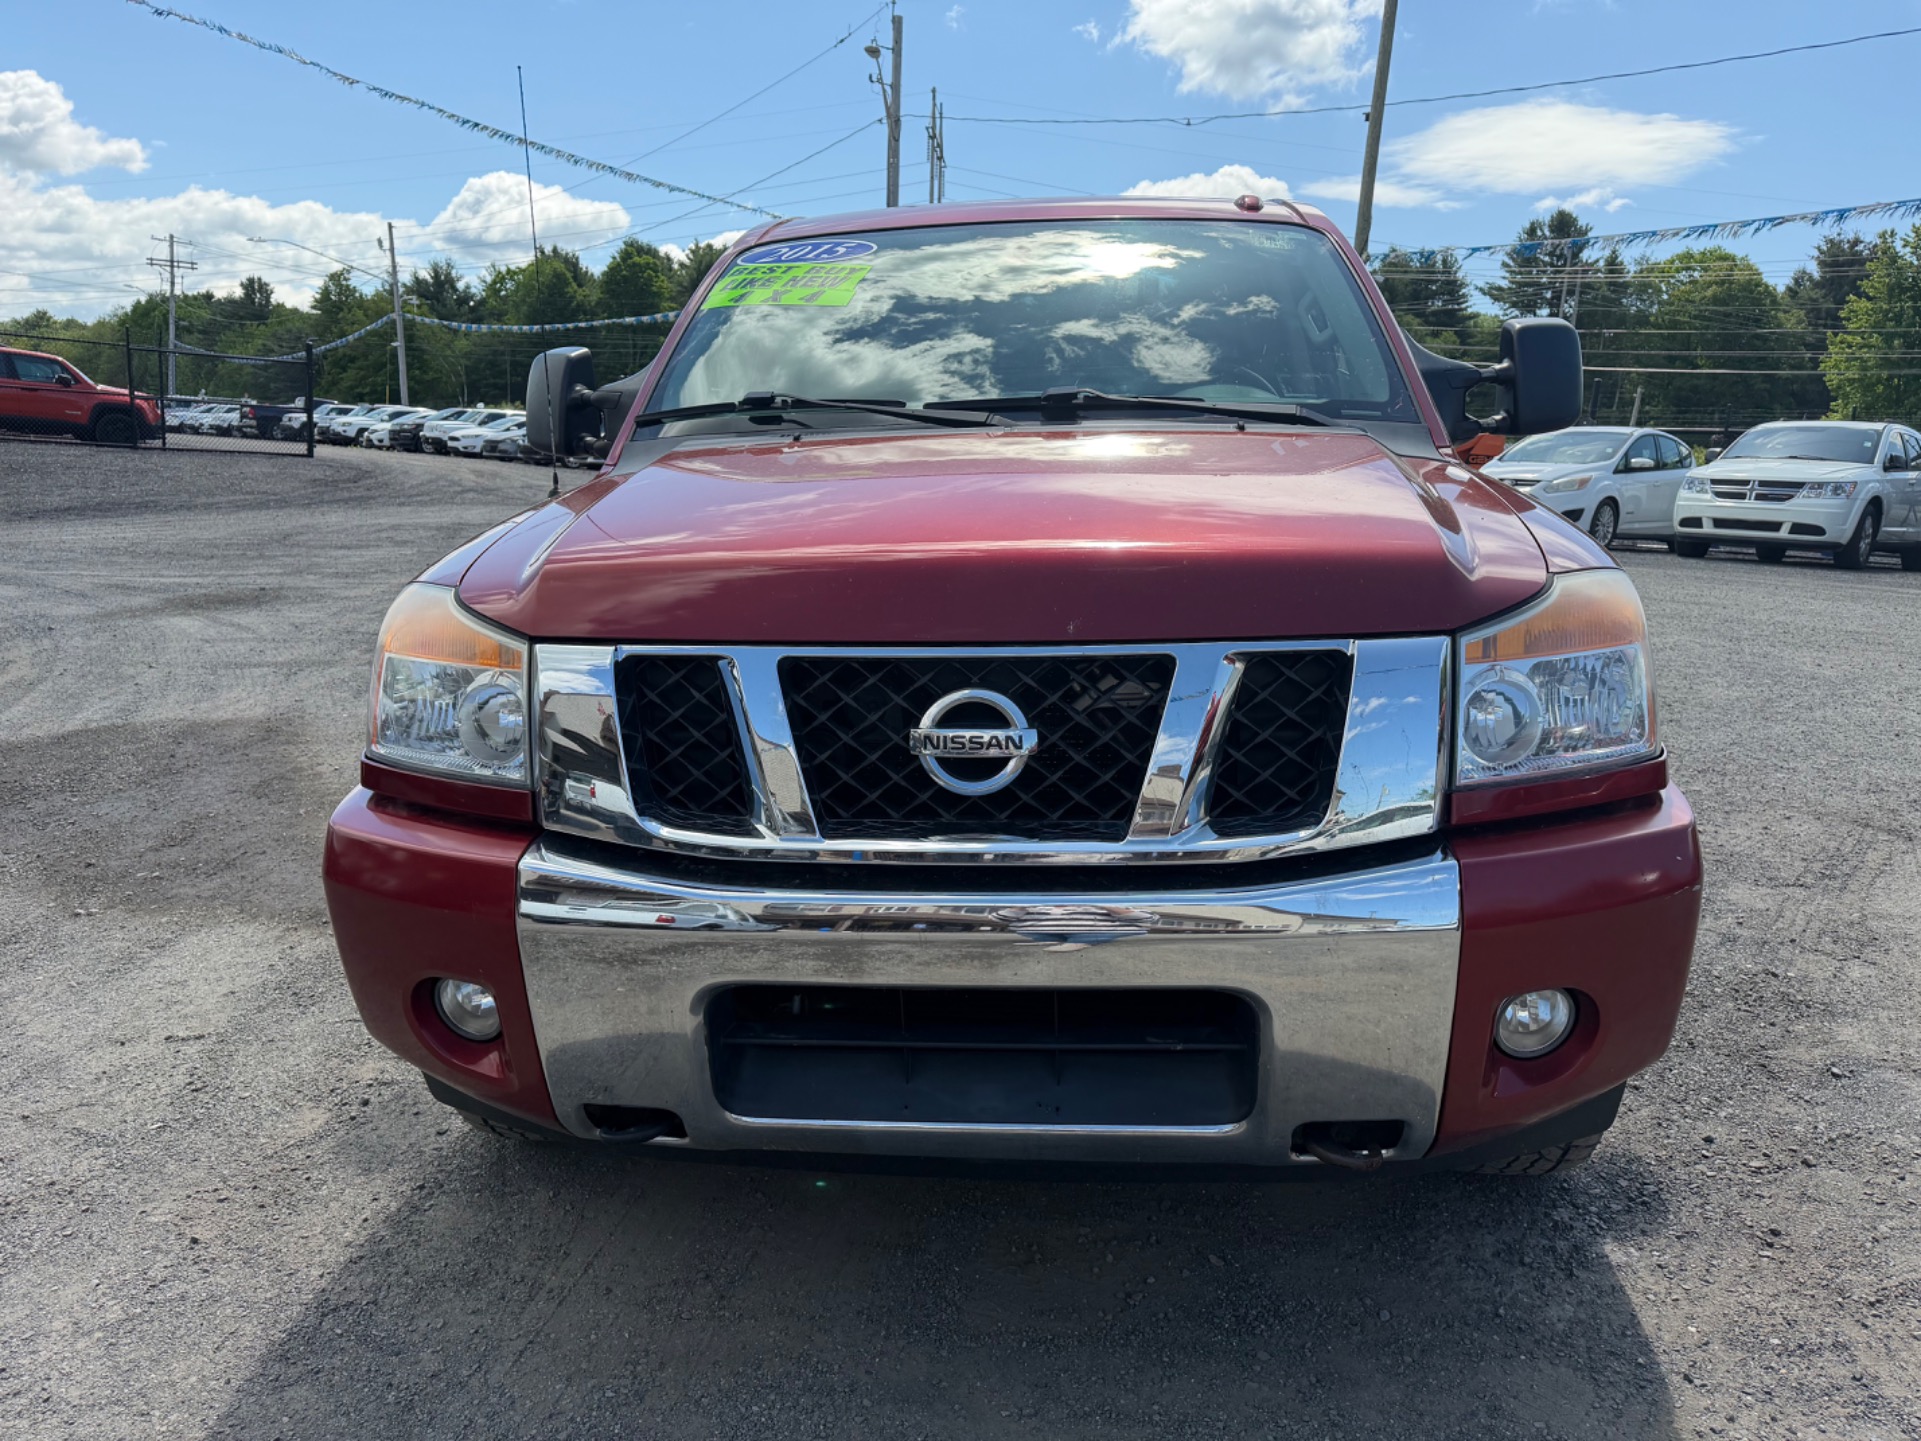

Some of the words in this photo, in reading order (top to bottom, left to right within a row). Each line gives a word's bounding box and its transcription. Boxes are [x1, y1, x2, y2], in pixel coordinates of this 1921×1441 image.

[756, 242, 857, 263] 2015
[727, 265, 802, 277] BEST
[804, 266, 868, 275] BUY
[720, 275, 782, 291] LIKE
[781, 275, 853, 289] NEW
[923, 735, 1023, 750] NISSAN
